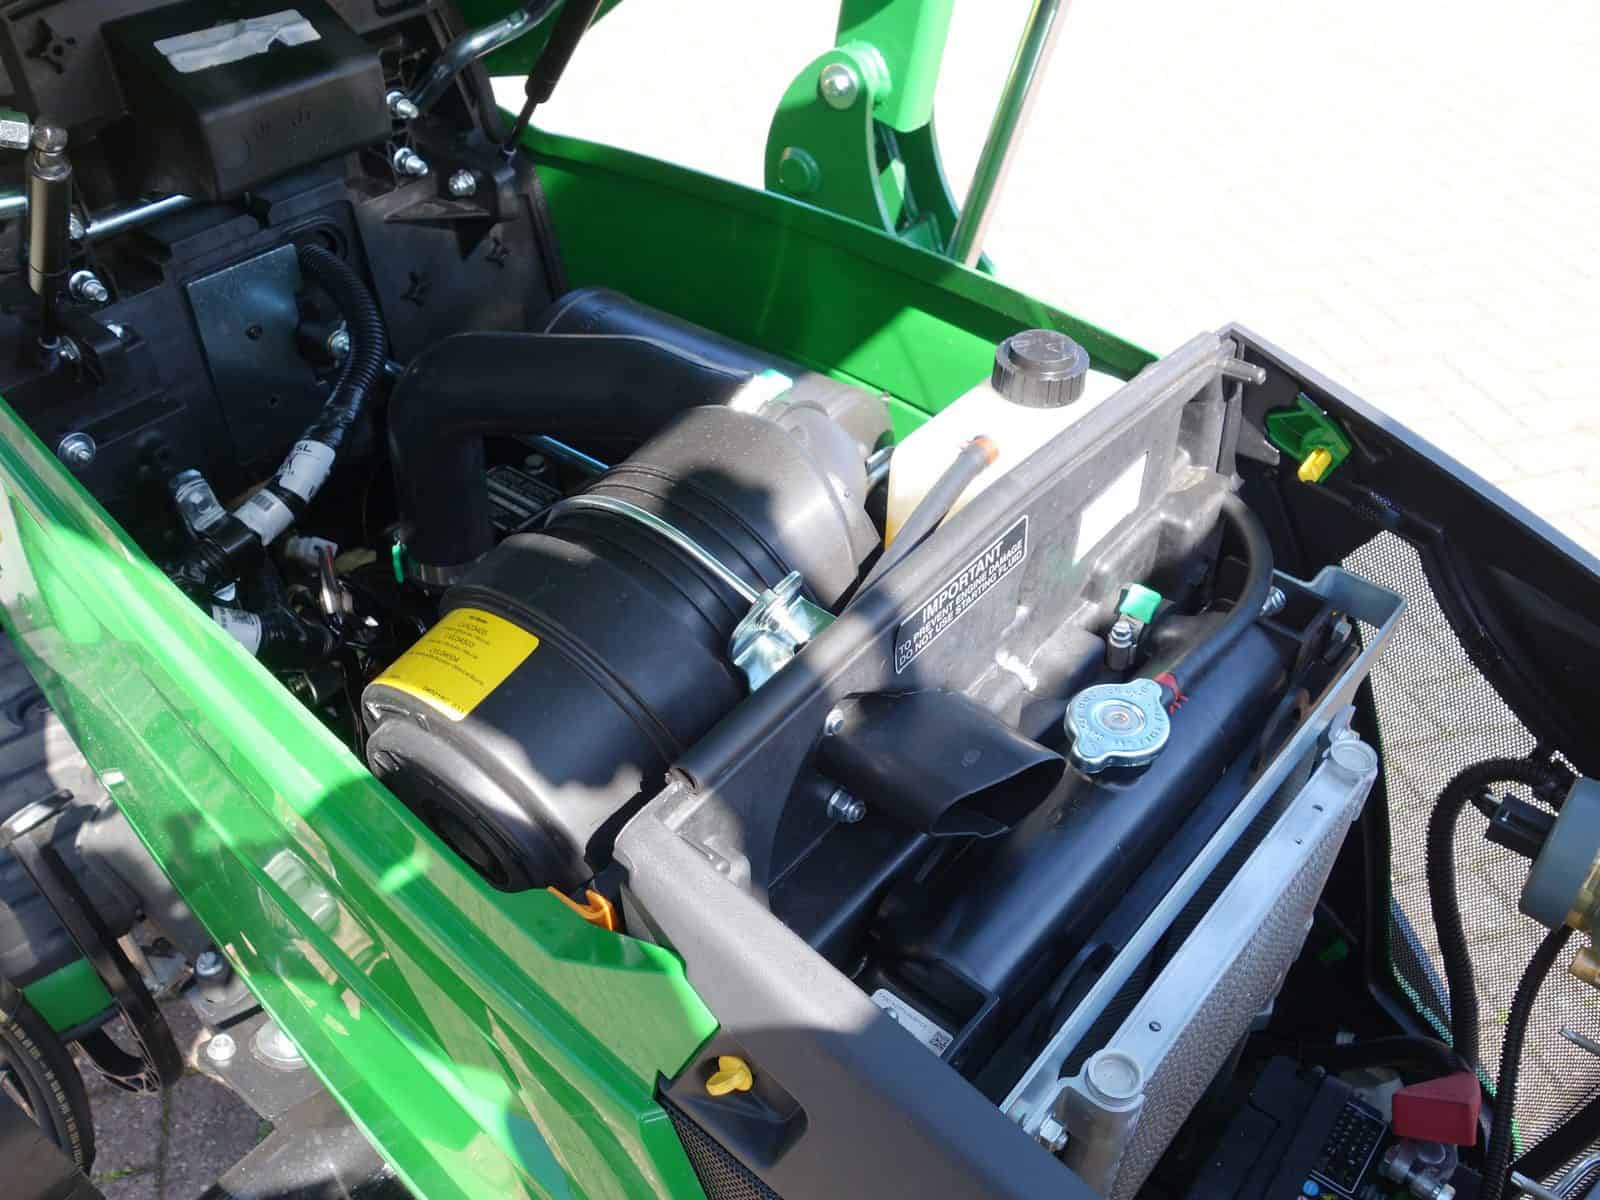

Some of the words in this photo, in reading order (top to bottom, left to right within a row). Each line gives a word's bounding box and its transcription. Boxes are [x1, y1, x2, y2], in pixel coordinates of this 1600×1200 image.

[898, 639, 912, 654] TO
[913, 601, 955, 643] PREVENT
[955, 574, 987, 605] ENGINE
[988, 538, 1024, 577] DAMAGE
[899, 650, 913, 666] DO
[915, 629, 934, 651] NOT
[935, 612, 954, 633] USE
[955, 573, 998, 616] STARTING
[998, 550, 1023, 575] FLUID
[922, 541, 1004, 623] IMPORTANT
